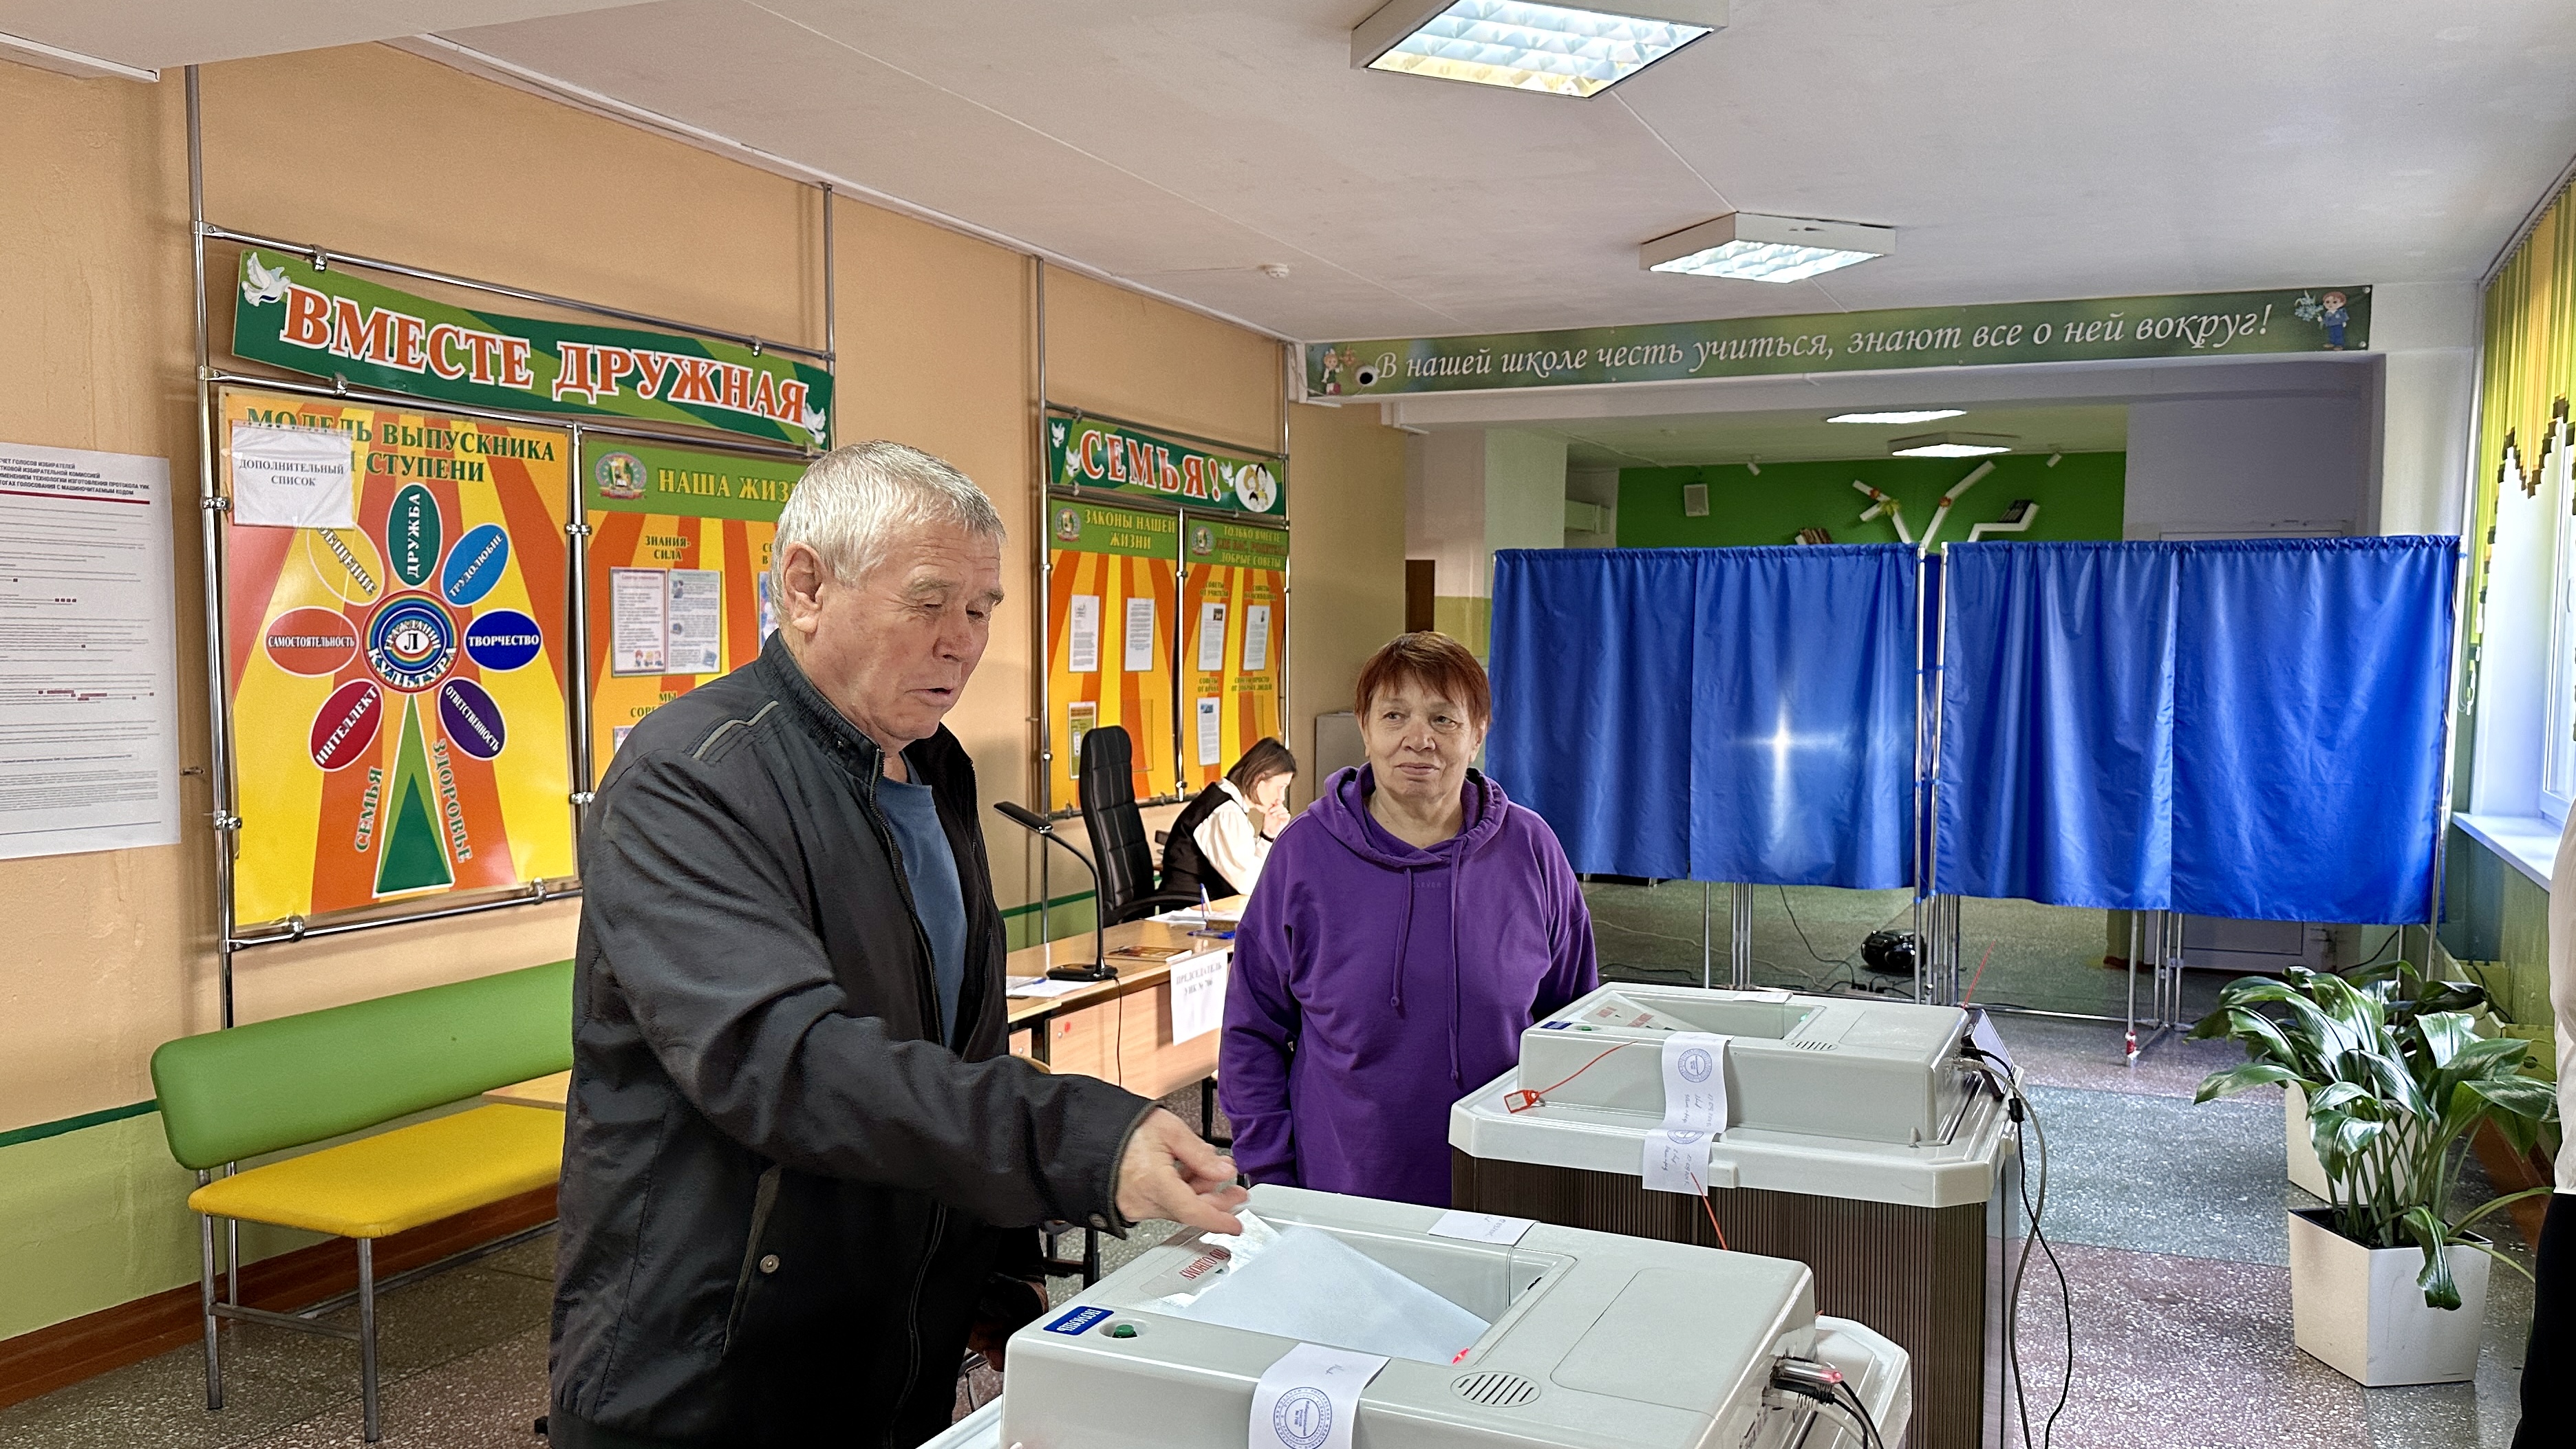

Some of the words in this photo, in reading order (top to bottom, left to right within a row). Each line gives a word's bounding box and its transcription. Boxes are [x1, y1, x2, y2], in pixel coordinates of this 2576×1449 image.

[281, 282, 533, 389] ВМЕСТЕ
[553, 340, 808, 427] ДРУЖНАЯ
[1376, 352, 1397, 378] В
[1406, 348, 1492, 378] нашей
[1501, 347, 1587, 378] школе
[1596, 341, 1684, 367] честь
[1688, 333, 1834, 373] учиться,
[1847, 325, 1962, 354] знают
[1972, 323, 2021, 348] все
[2033, 322, 2052, 345] о
[2064, 312, 2125, 344] ней
[2135, 304, 2273, 350] вокруг!
[382, 422, 555, 462] ВЫПУСКНИКА
[239, 459, 345, 475] ДОПОЛНИТЕЛЬНЫЙ
[271, 475, 316, 486] СПИСОК
[366, 451, 485, 482] СТУПЕНИ
[1080, 428, 1222, 502] СЕМЬЯ!
[658, 469, 731, 498] НАША
[738, 477, 797, 503] ЖИЗ
[407, 493, 420, 579] ДРУЖБА
[1084, 508, 1133, 528] ЗАКОНЫ
[1137, 516, 1175, 534] НАШЕЙ
[1223, 525, 1253, 539] ТОЛЬКО
[644, 535, 691, 549] ЗНАНИЯ-
[654, 549, 683, 561] СИЛА
[1110, 532, 1152, 550] ЖИЗНИ
[449, 533, 504, 597] ТРУДОЛЮБИЕ
[1221, 552, 1251, 565] ДОБРЫЕ
[1253, 556, 1281, 567] СОВЕТЫ
[268, 635, 356, 649] САМОСТОЯТЕЛЬНОСТЬ
[383, 619, 442, 651] ГРАЖДАНИН
[468, 634, 540, 647] ТВОРЧЕСТВО
[366, 646, 458, 688] КУЛЬТУРА
[658, 691, 677, 702] МЫ
[315, 685, 378, 766] ИНТЕЛЛЕКТ
[444, 685, 500, 753] ОТВЕТСТВЕННОСТЬ
[354, 766, 383, 852] СЕМЬЯ
[433, 738, 473, 863] ЗДОРОВЬЕ
[1179, 1256, 1218, 1281] ОДНОМУ
[1057, 1309, 1103, 1332] ПОМОЩЬ
